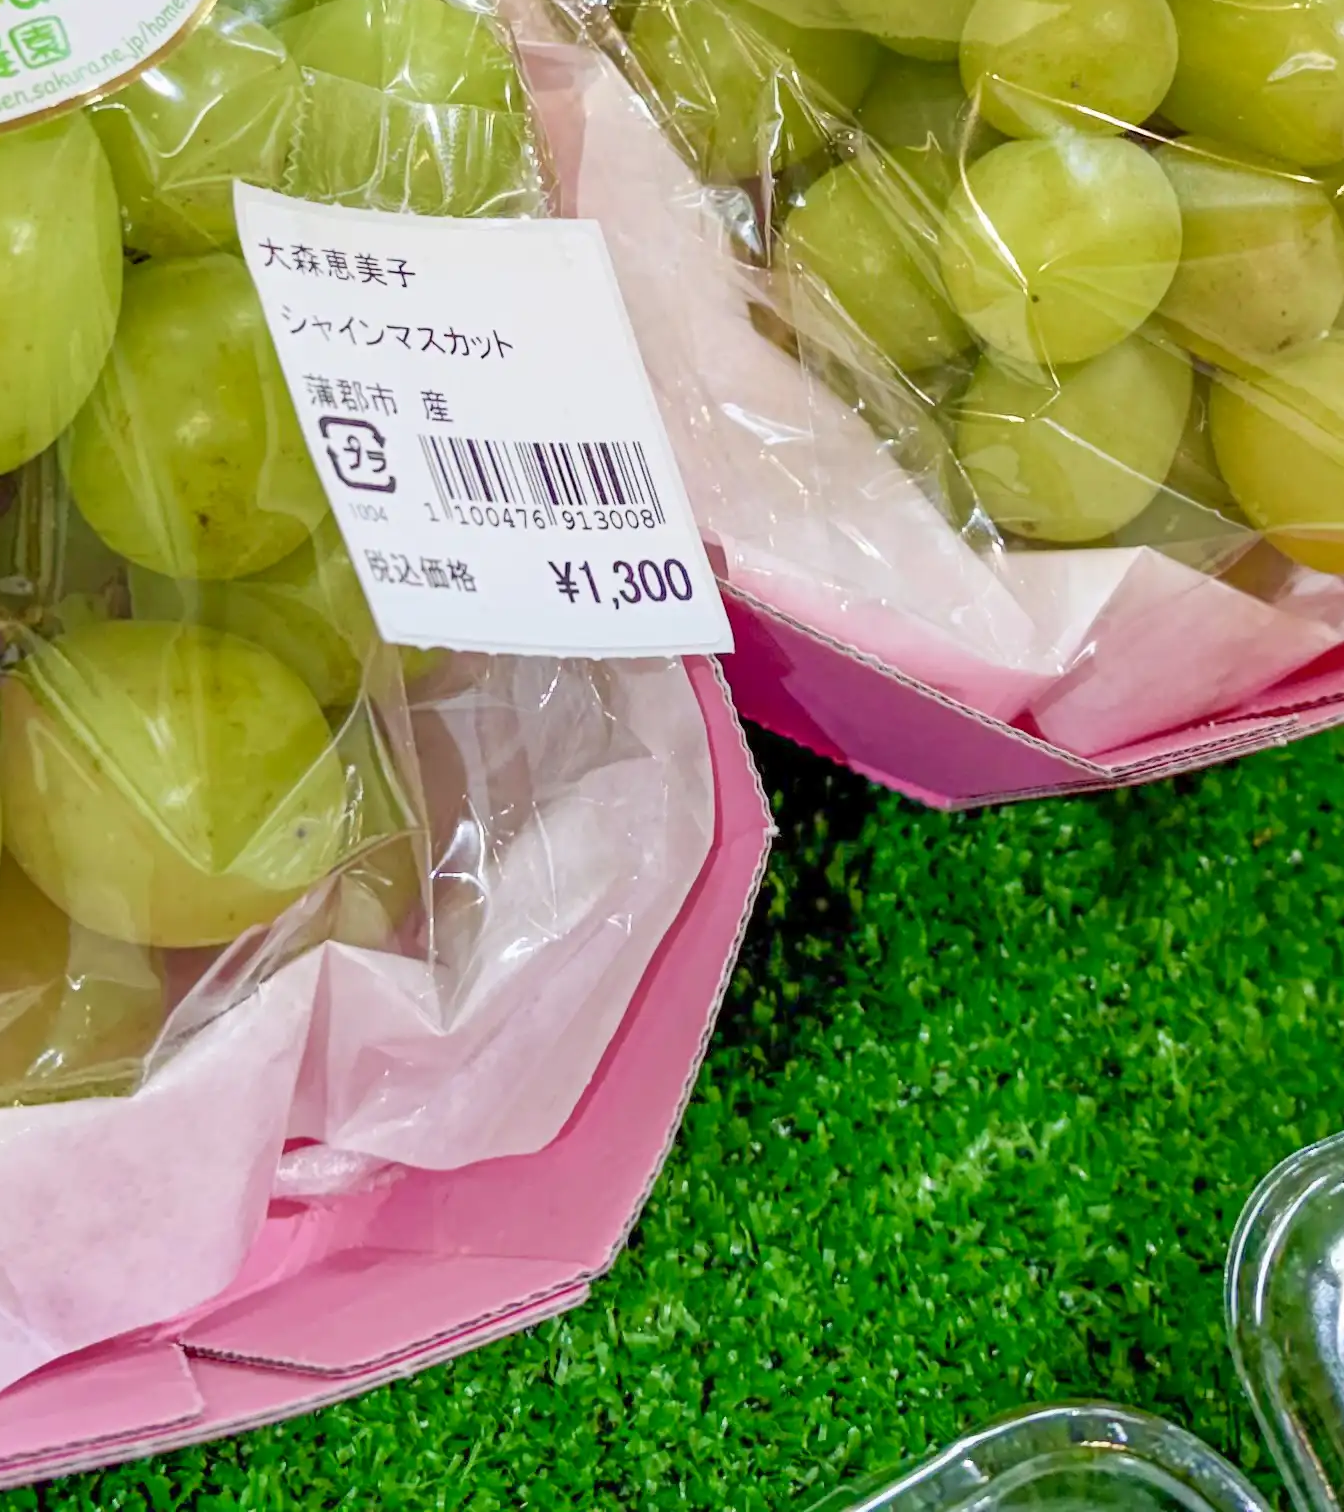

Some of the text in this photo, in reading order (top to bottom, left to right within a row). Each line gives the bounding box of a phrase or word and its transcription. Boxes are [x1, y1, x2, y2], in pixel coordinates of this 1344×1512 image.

[259, 238, 416, 288] 大森恵美子
[281, 305, 514, 360] シャインマスカット
[302, 373, 454, 422] 蒲郡市 産
[425, 502, 657, 532] 1 100476 913008
[364, 548, 477, 592] 税込価格
[548, 557, 694, 611] ¥1,300
